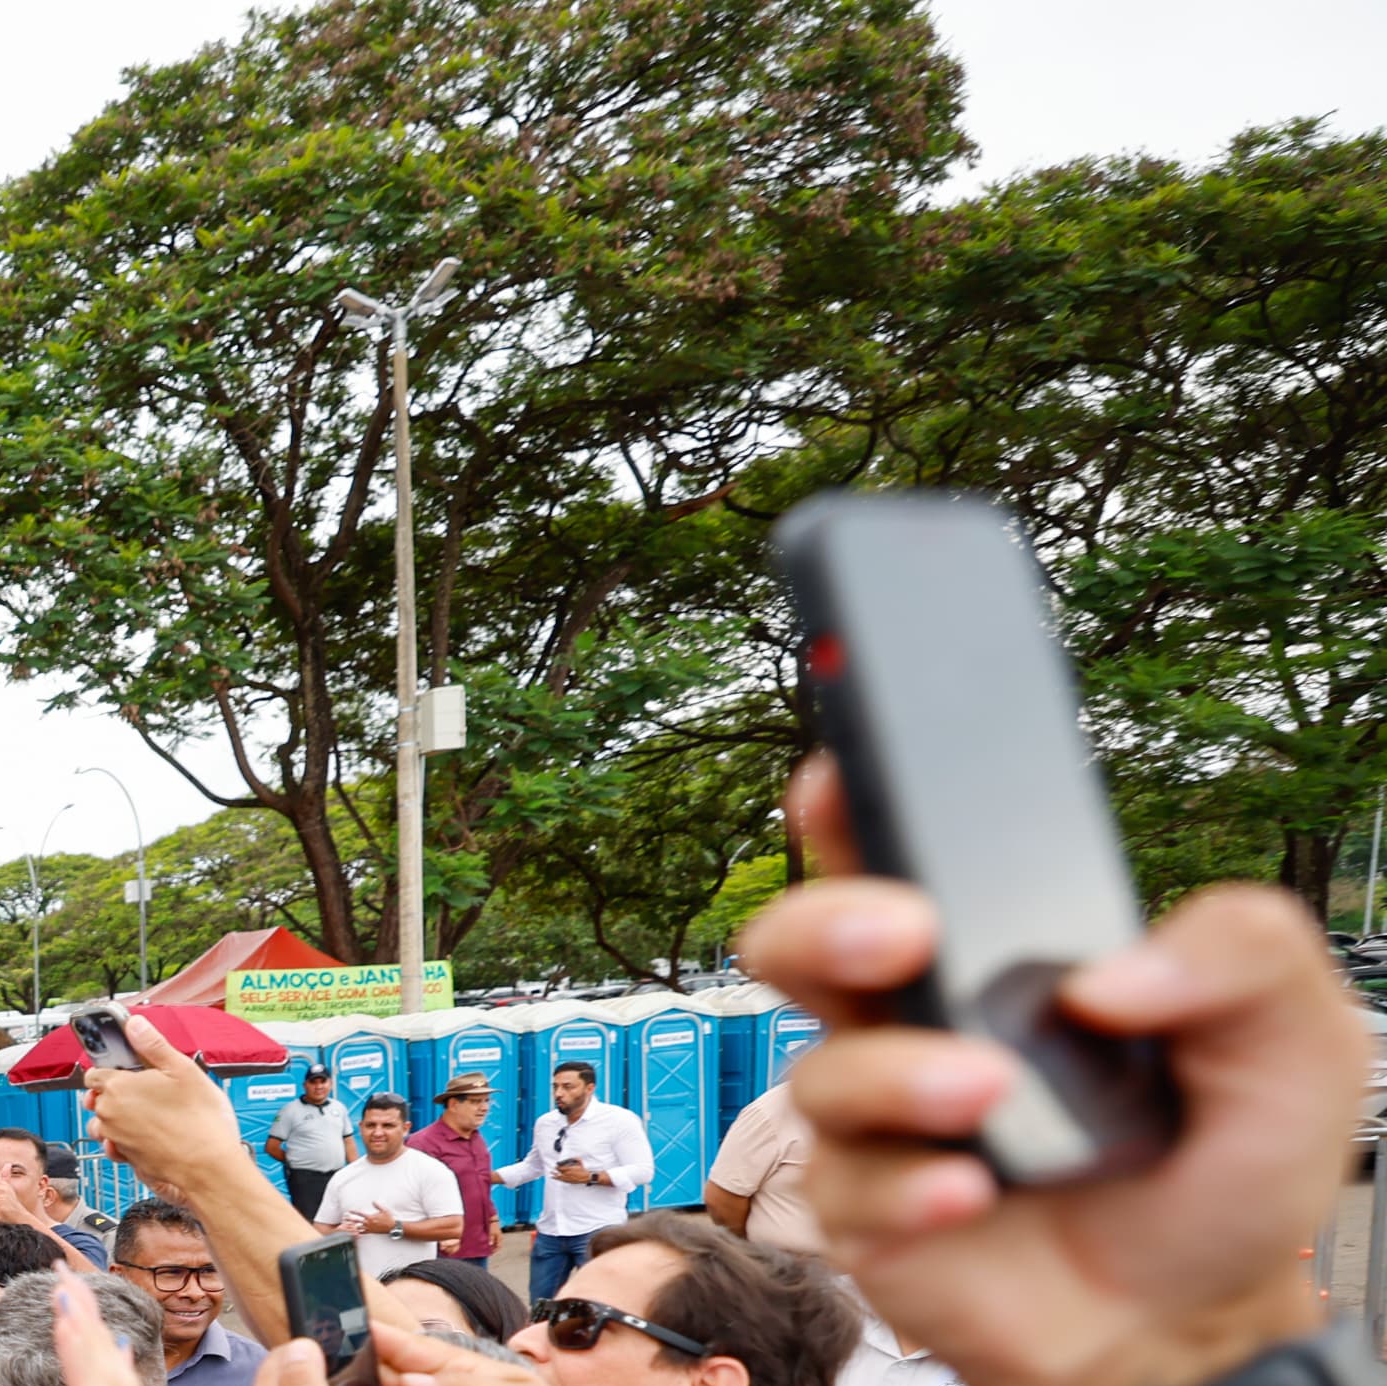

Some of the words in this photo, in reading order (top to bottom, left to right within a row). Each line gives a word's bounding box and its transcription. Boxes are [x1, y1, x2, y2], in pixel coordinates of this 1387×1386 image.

[240, 971, 334, 990] ALMOÇO
[340, 974, 350, 985] e
[353, 964, 447, 985] JANTHA
[239, 989, 332, 1004] SELF-SERVICE
[337, 988, 368, 1000] COM
